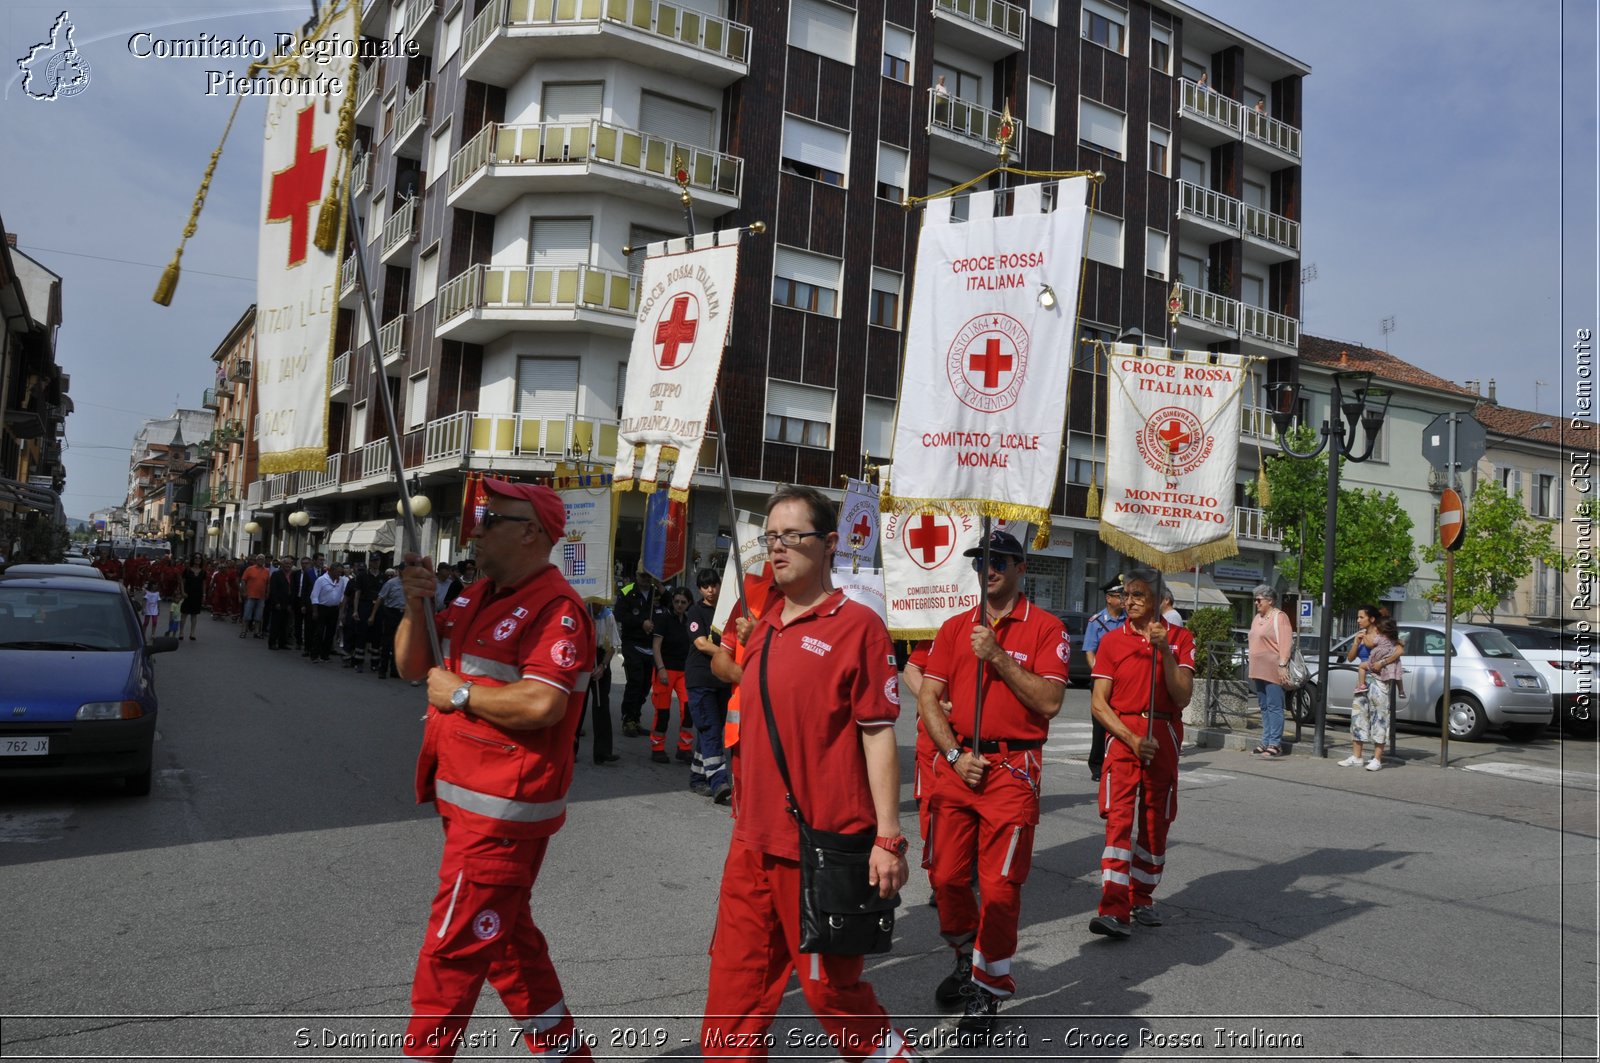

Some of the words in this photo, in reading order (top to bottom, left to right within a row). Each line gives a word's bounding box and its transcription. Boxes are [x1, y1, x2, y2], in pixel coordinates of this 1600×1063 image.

[952, 256, 995, 273] CROCE
[999, 251, 1044, 269] ROSSA
[966, 273, 1025, 291] ITALIANA
[639, 282, 666, 323] CROCE
[666, 264, 694, 287] ROSSA
[950, 333, 970, 378] AGOSTO
[968, 317, 989, 335] 1864
[1121, 360, 1176, 378] CROCE
[1183, 367, 1233, 382] ROSSA
[1139, 378, 1214, 398] ITALIANA
[654, 400, 664, 411] DI
[1163, 411, 1190, 421] GINEVRA
[922, 431, 991, 447] COMITATO
[1000, 433, 1039, 450] LOCALE
[957, 452, 1009, 468] MONALE
[1183, 436, 1215, 474] SOCCORSO
[1125, 488, 1218, 508] MONTIGLIO
[1114, 502, 1225, 524] MONFERRATO
[1156, 519, 1181, 528] ASTI
[930, 584, 949, 595] LOCALE
[951, 584, 959, 593] DI
[892, 596, 945, 611] MONTEGROSSO
[948, 594, 978, 608] D'ASTI
[6, 741, 28, 752] 762
[34, 741, 47, 752] JX
